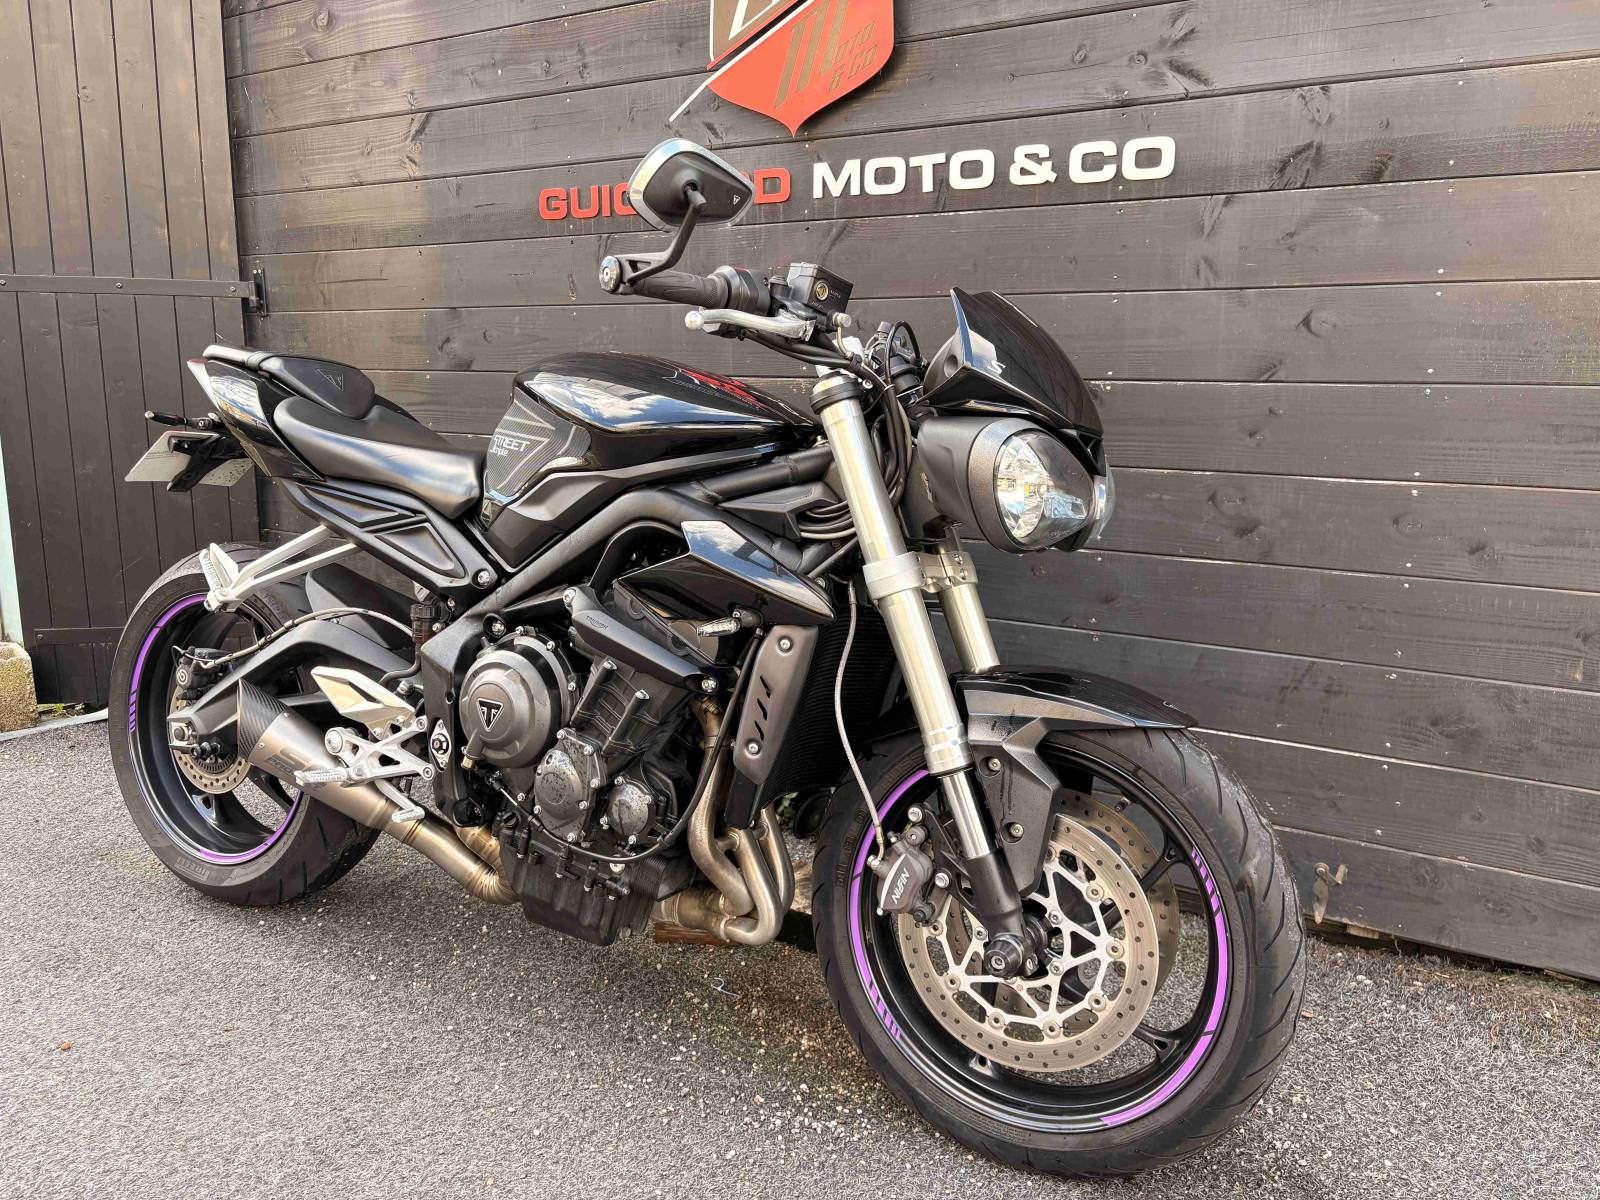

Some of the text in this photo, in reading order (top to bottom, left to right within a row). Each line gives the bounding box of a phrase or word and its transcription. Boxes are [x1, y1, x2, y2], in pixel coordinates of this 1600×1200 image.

[812, 149, 995, 198] MOTO
[1009, 144, 1057, 186] &
[1068, 136, 1176, 184] CO
